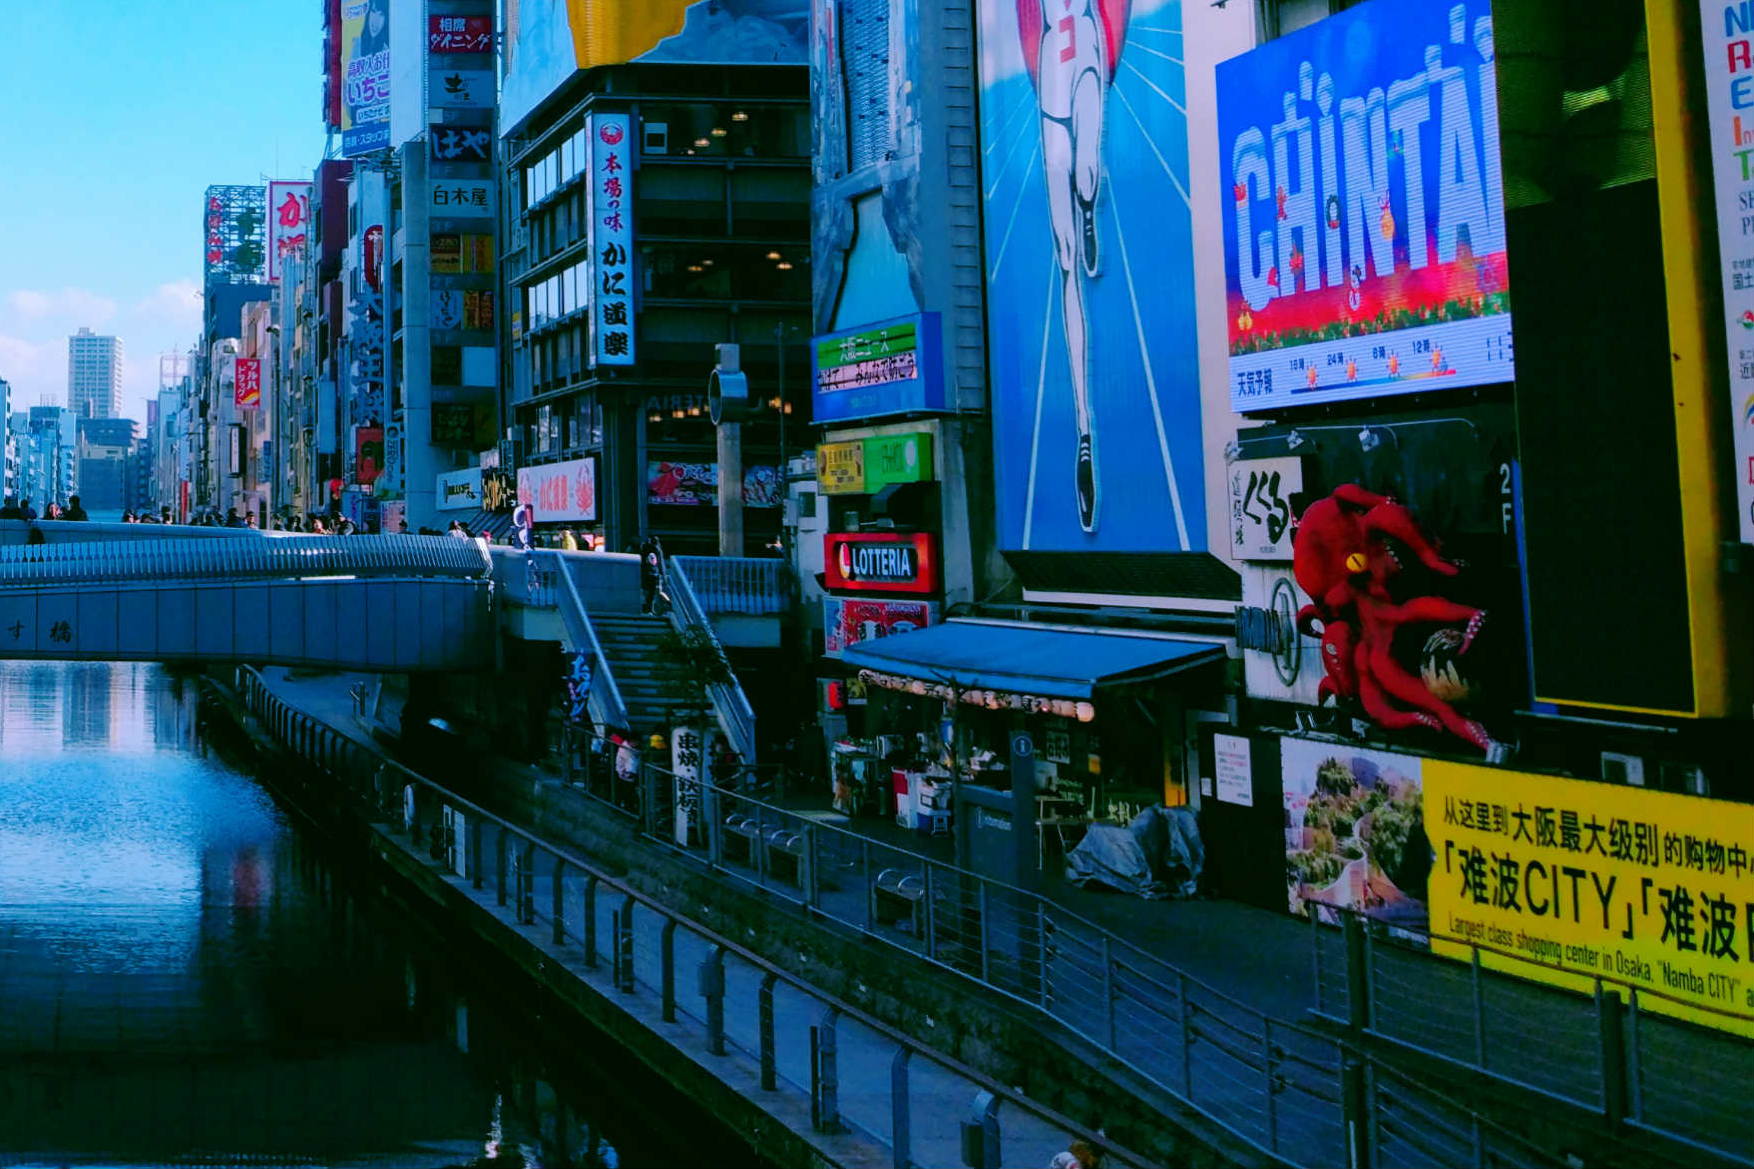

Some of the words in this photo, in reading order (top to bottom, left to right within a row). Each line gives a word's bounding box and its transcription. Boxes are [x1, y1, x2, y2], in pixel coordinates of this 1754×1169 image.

[433, 185, 487, 207] 白木屋
[600, 152, 624, 233] 本場の味
[600, 242, 629, 357] かに道楽
[247, 361, 258, 391] ツルハ
[1237, 367, 1274, 398] 天気予報
[852, 547, 912, 577] LOTTERIA
[1448, 911, 1485, 942] Largest
[1488, 921, 1514, 948] class
[1517, 927, 1563, 967] shopping
[1565, 943, 1599, 968] center
[1602, 946, 1613, 972] in
